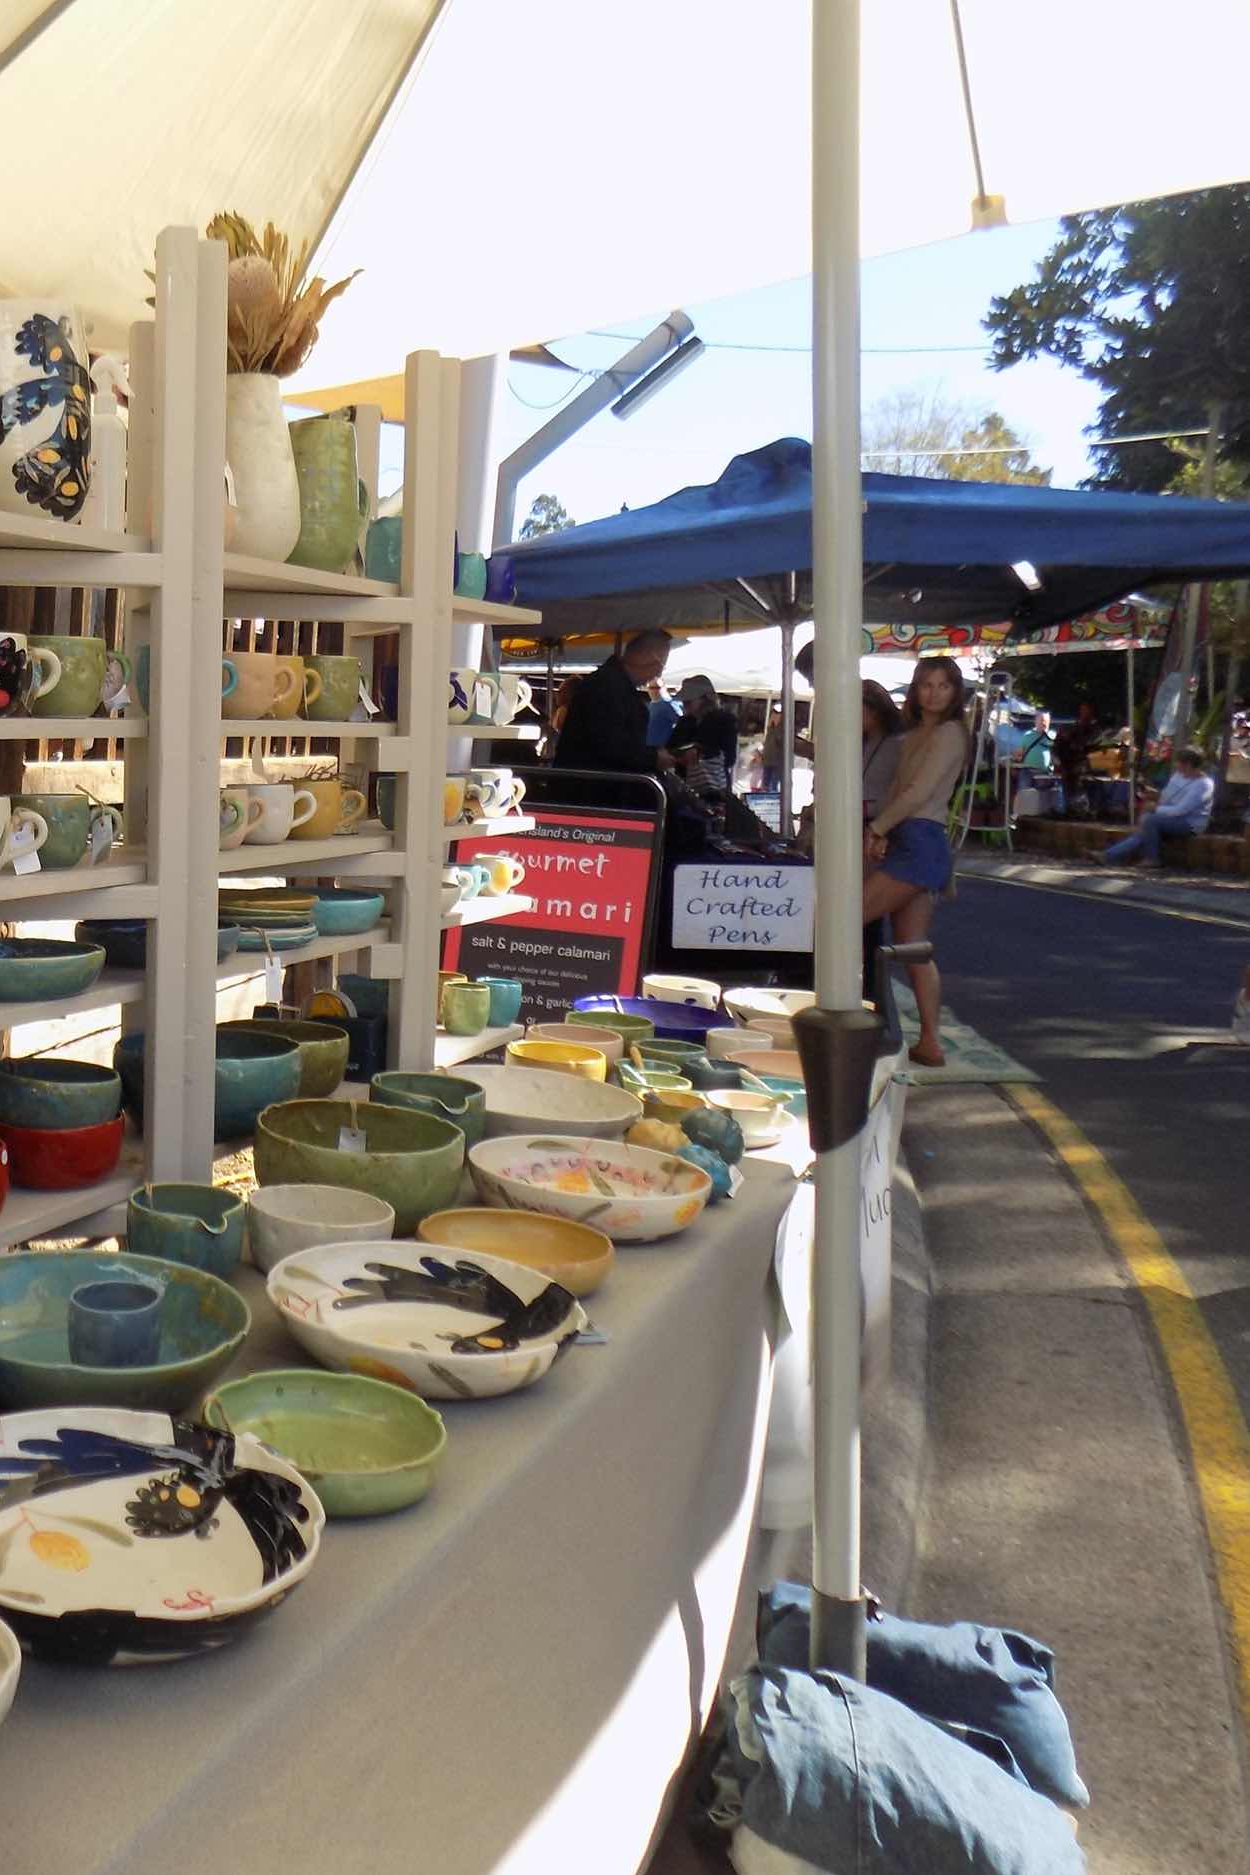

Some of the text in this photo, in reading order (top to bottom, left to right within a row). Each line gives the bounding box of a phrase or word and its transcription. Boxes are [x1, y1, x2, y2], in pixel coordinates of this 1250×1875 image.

[572, 828, 615, 843] Original
[700, 869, 788, 889] Hand
[686, 896, 800, 920] Crafted
[709, 925, 776, 945] Pens
[471, 936, 611, 961] salt & pepper calamari
[536, 995, 544, 1006] &
[546, 998, 574, 1009] garlic
